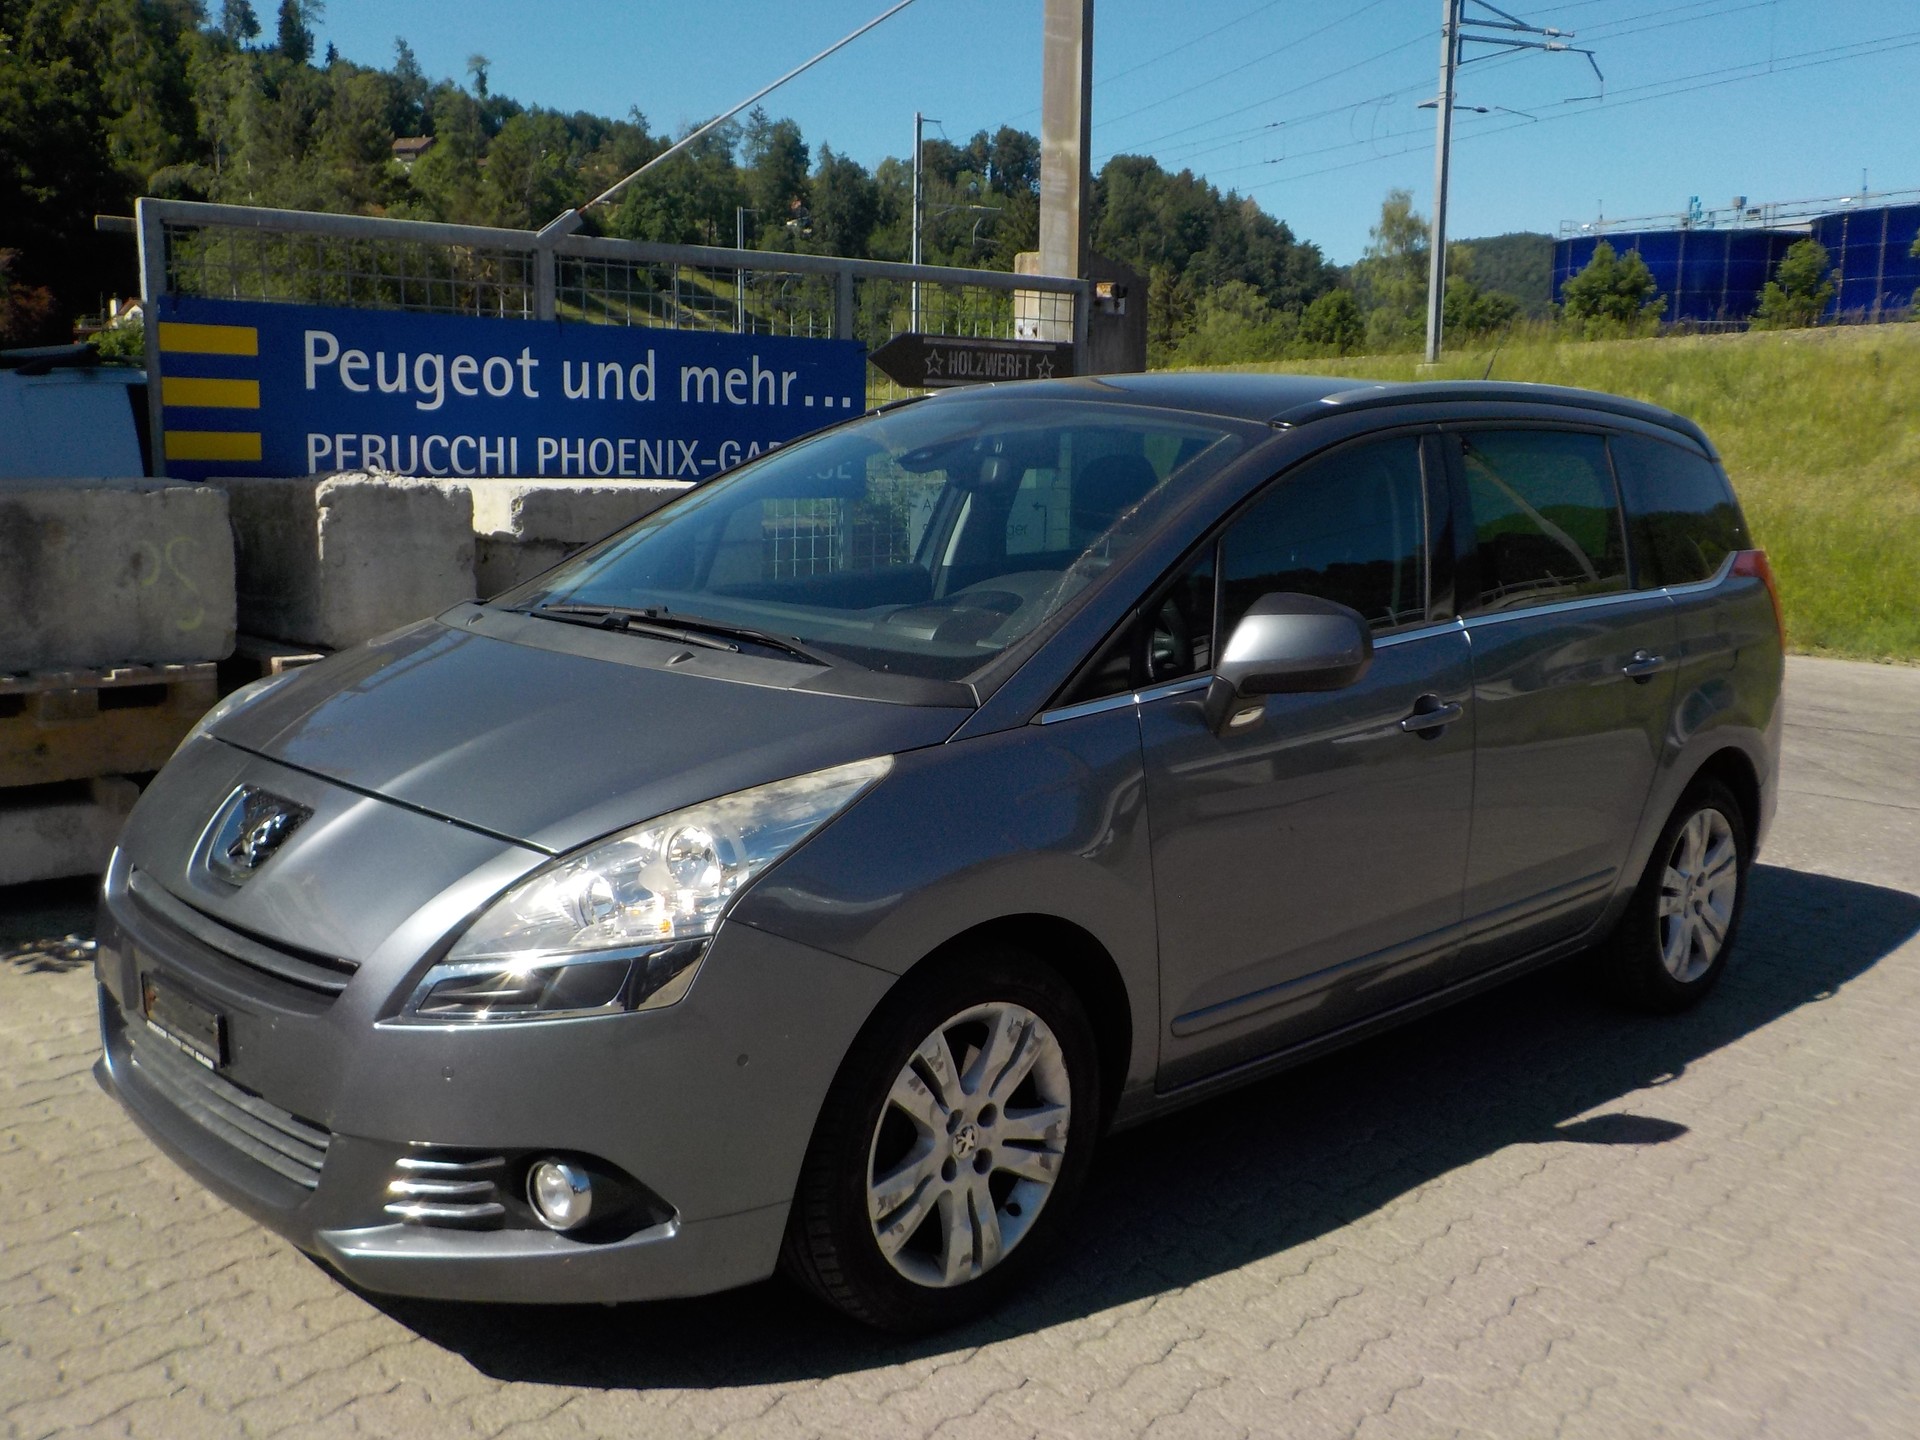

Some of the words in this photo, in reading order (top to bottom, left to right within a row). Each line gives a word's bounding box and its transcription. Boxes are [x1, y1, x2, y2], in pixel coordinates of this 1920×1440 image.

[304, 329, 539, 410] Peugeot
[563, 349, 656, 401] und
[681, 355, 851, 408] mehr...
[948, 350, 1033, 377] HOLZWERFT
[306, 432, 518, 476] PERUCCHI
